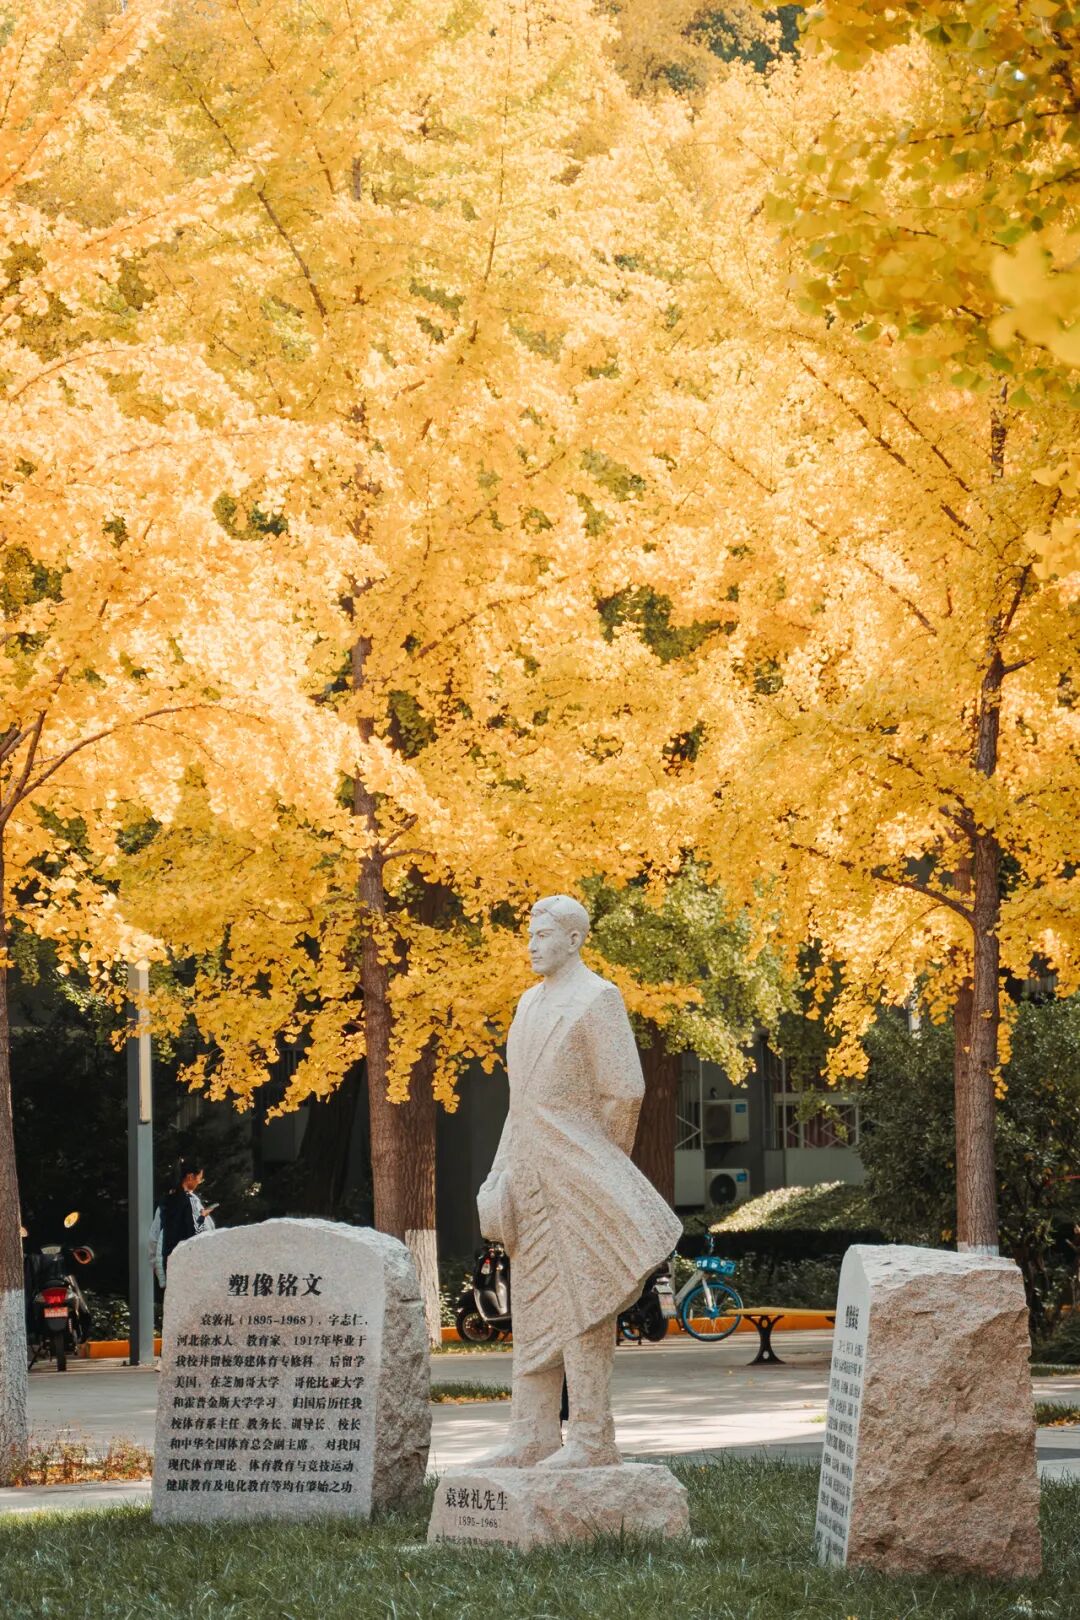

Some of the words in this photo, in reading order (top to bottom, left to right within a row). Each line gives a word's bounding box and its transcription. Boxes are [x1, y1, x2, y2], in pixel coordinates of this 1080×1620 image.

[227, 1273, 323, 1297] 塑像铭文
[445, 1487, 508, 1511] 袁敦礼先生
